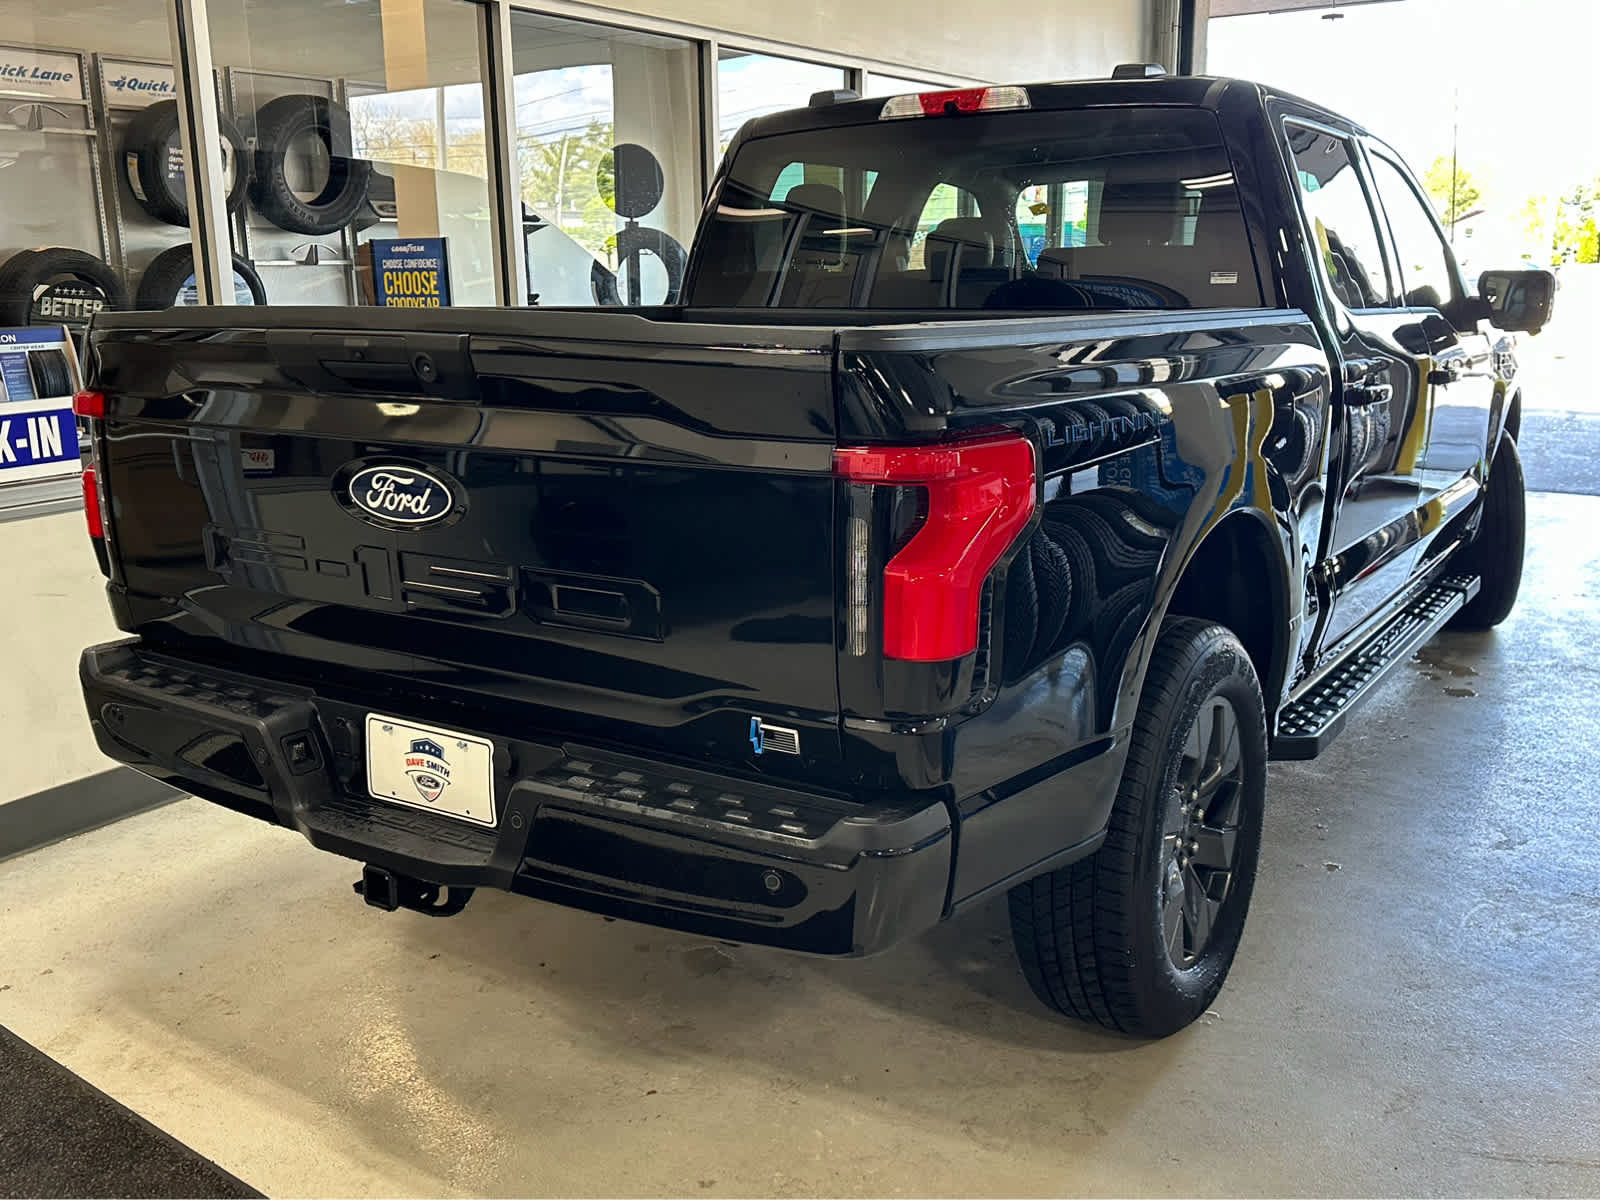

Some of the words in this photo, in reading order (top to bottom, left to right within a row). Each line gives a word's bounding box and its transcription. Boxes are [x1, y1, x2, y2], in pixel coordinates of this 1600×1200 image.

[0, 64, 28, 78] ick
[31, 67, 73, 82] Lane
[127, 78, 169, 92] Quick
[391, 244, 425, 253] GOODYEAR
[382, 259, 403, 269] CHOOSE
[404, 258, 438, 269] CONFIDENCE
[383, 271, 440, 295] CHOOSE
[40, 297, 105, 317] BETTER
[0, 334, 17, 344] ON
[366, 472, 432, 515] Ford
[202, 524, 664, 643] F-150
[405, 758, 425, 767] DAVE
[426, 760, 451, 778] SMITH
